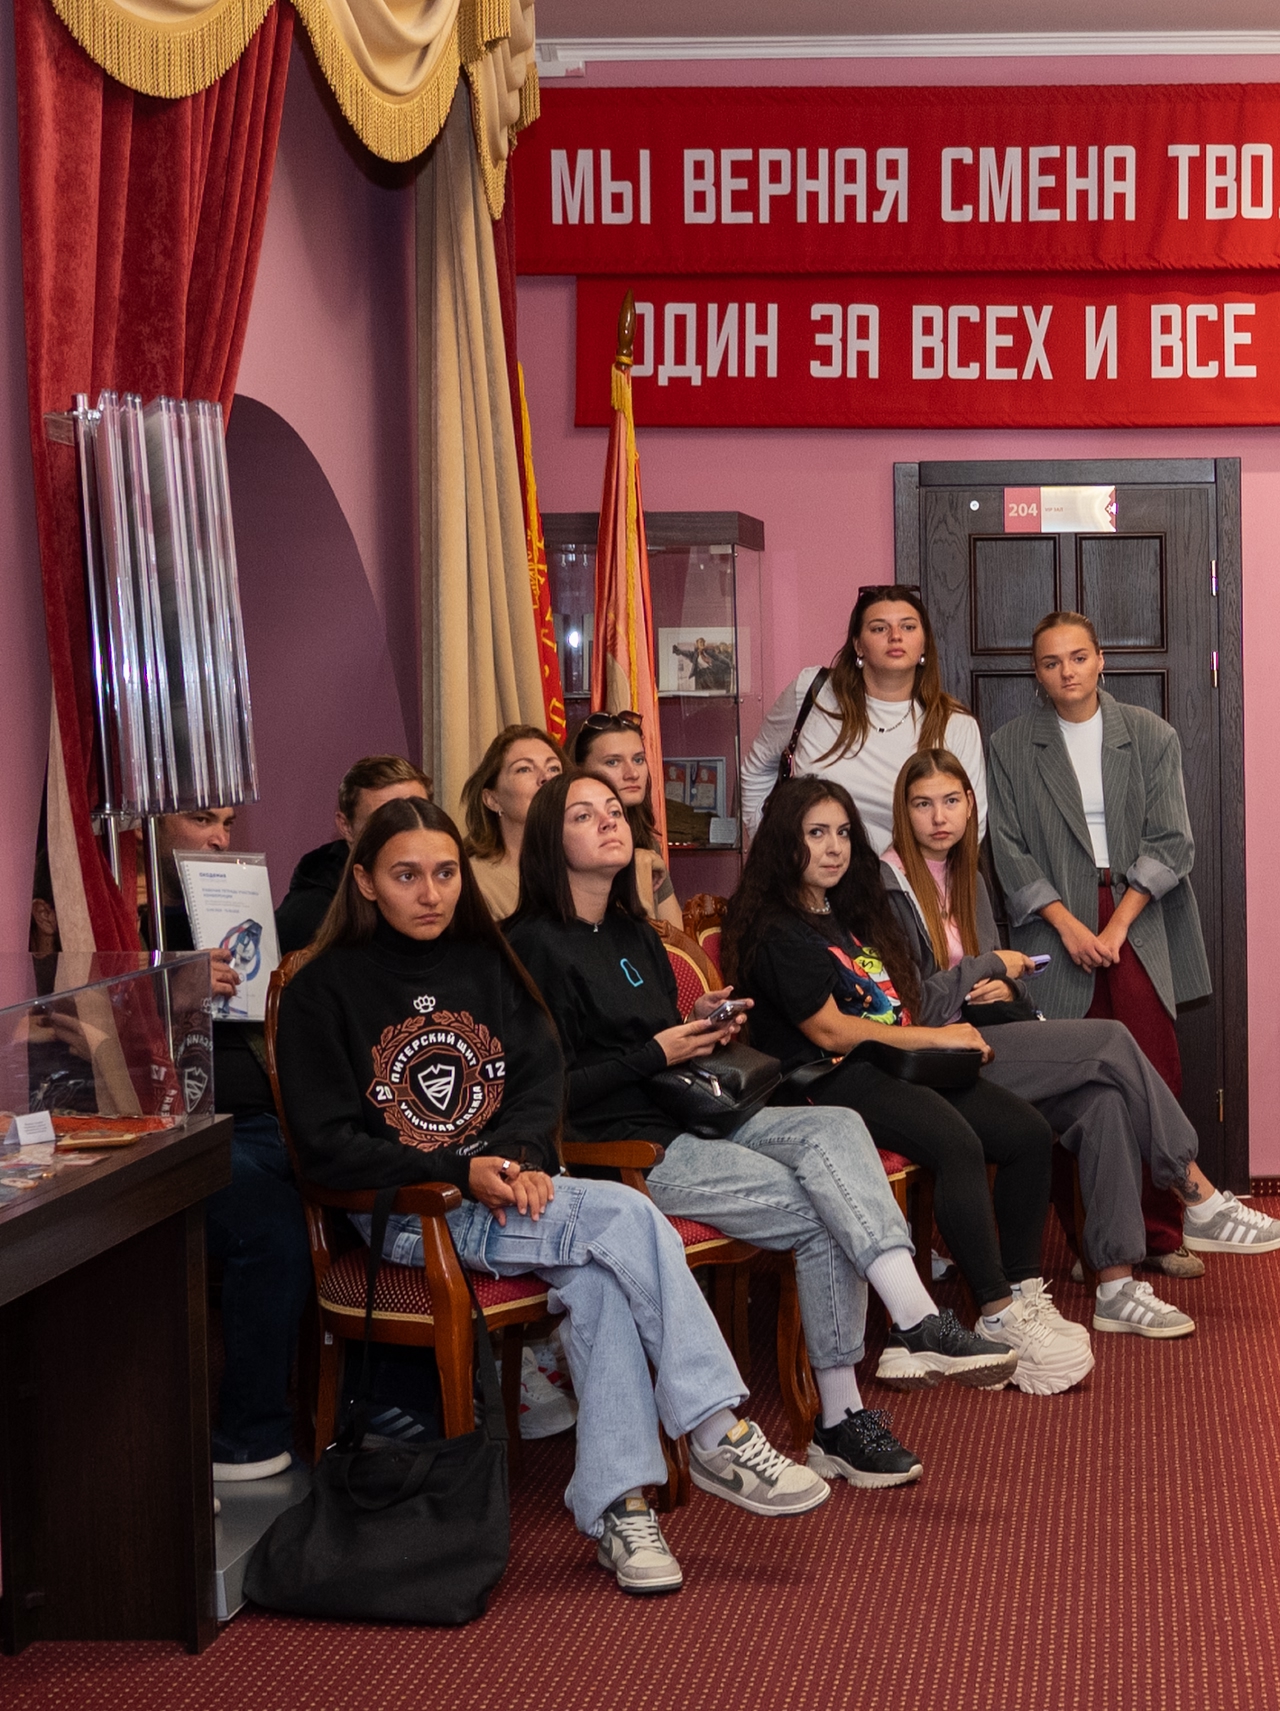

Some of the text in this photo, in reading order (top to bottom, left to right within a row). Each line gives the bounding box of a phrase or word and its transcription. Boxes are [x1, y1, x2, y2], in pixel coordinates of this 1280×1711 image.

[550, 149, 651, 225] МЫ
[683, 147, 909, 224] ВЕРНАЯ
[941, 144, 1136, 223] СМЕНА
[809, 303, 880, 379] ЗА
[912, 304, 1054, 380] ВСЕХ
[1085, 305, 1118, 380] И
[1150, 302, 1258, 379] ВСЕ
[1008, 502, 1038, 517] 204
[391, 1032, 477, 1083] ПИТЕРСКИЙ ЩИТ
[485, 1061, 505, 1078] 12
[375, 1085, 393, 1100] 20
[400, 1085, 483, 1132] УЛИЧНАЯ ОДЕЖДА
